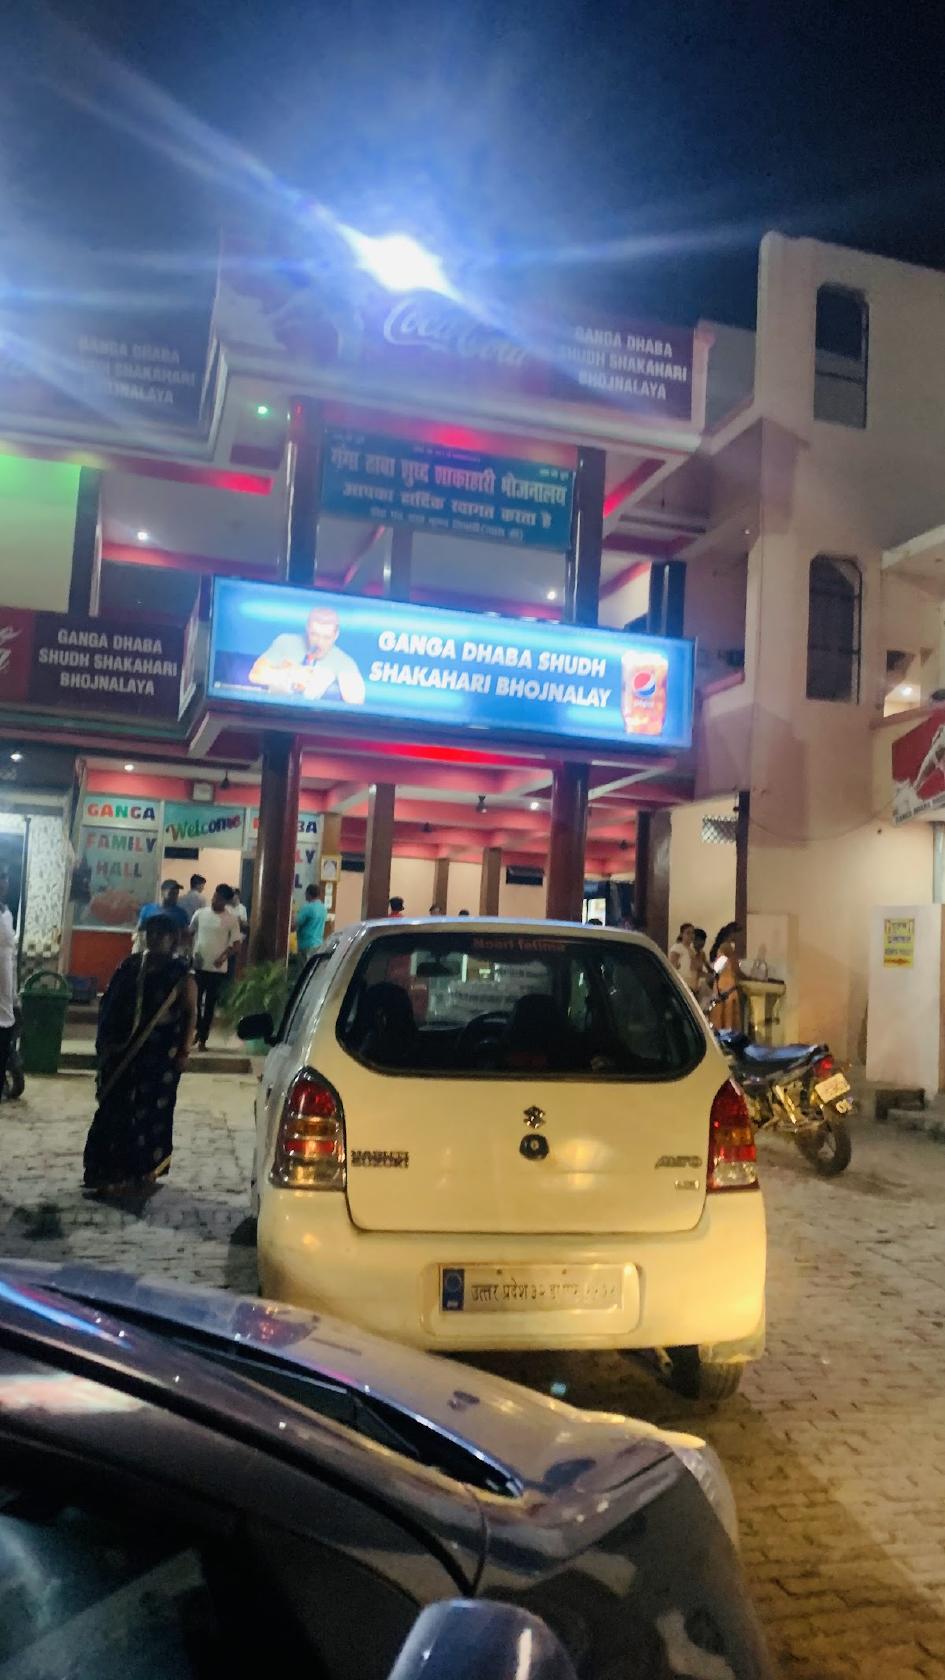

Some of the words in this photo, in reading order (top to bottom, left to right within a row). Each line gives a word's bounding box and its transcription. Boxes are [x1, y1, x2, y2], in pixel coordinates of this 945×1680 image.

[576, 326, 622, 348] GANGA
[627, 335, 673, 358] DHABA
[608, 354, 688, 382] SHAKAHARI
[578, 368, 667, 400] BHOJNALAYA
[57, 628, 109, 649] GANGA
[112, 634, 163, 655] DHABA
[378, 630, 457, 660] GANGA
[461, 641, 532, 670] DHABA
[537, 651, 607, 679] SHUDH
[38, 647, 90, 668] SHUDH
[93, 654, 178, 677] SHAKAHARI
[60, 671, 155, 696] BHOJNALAYA
[368, 660, 491, 694] SHAKAHARI
[494, 676, 612, 708] BHOJNALAY
[87, 803, 156, 821] GANGA
[166, 814, 241, 842] Welcome
[86, 832, 157, 854] FAMILY
[97, 859, 142, 879] HALL
[471, 1284, 499, 1302] उत्तर
[503, 1277, 528, 1300] प्रदेश
